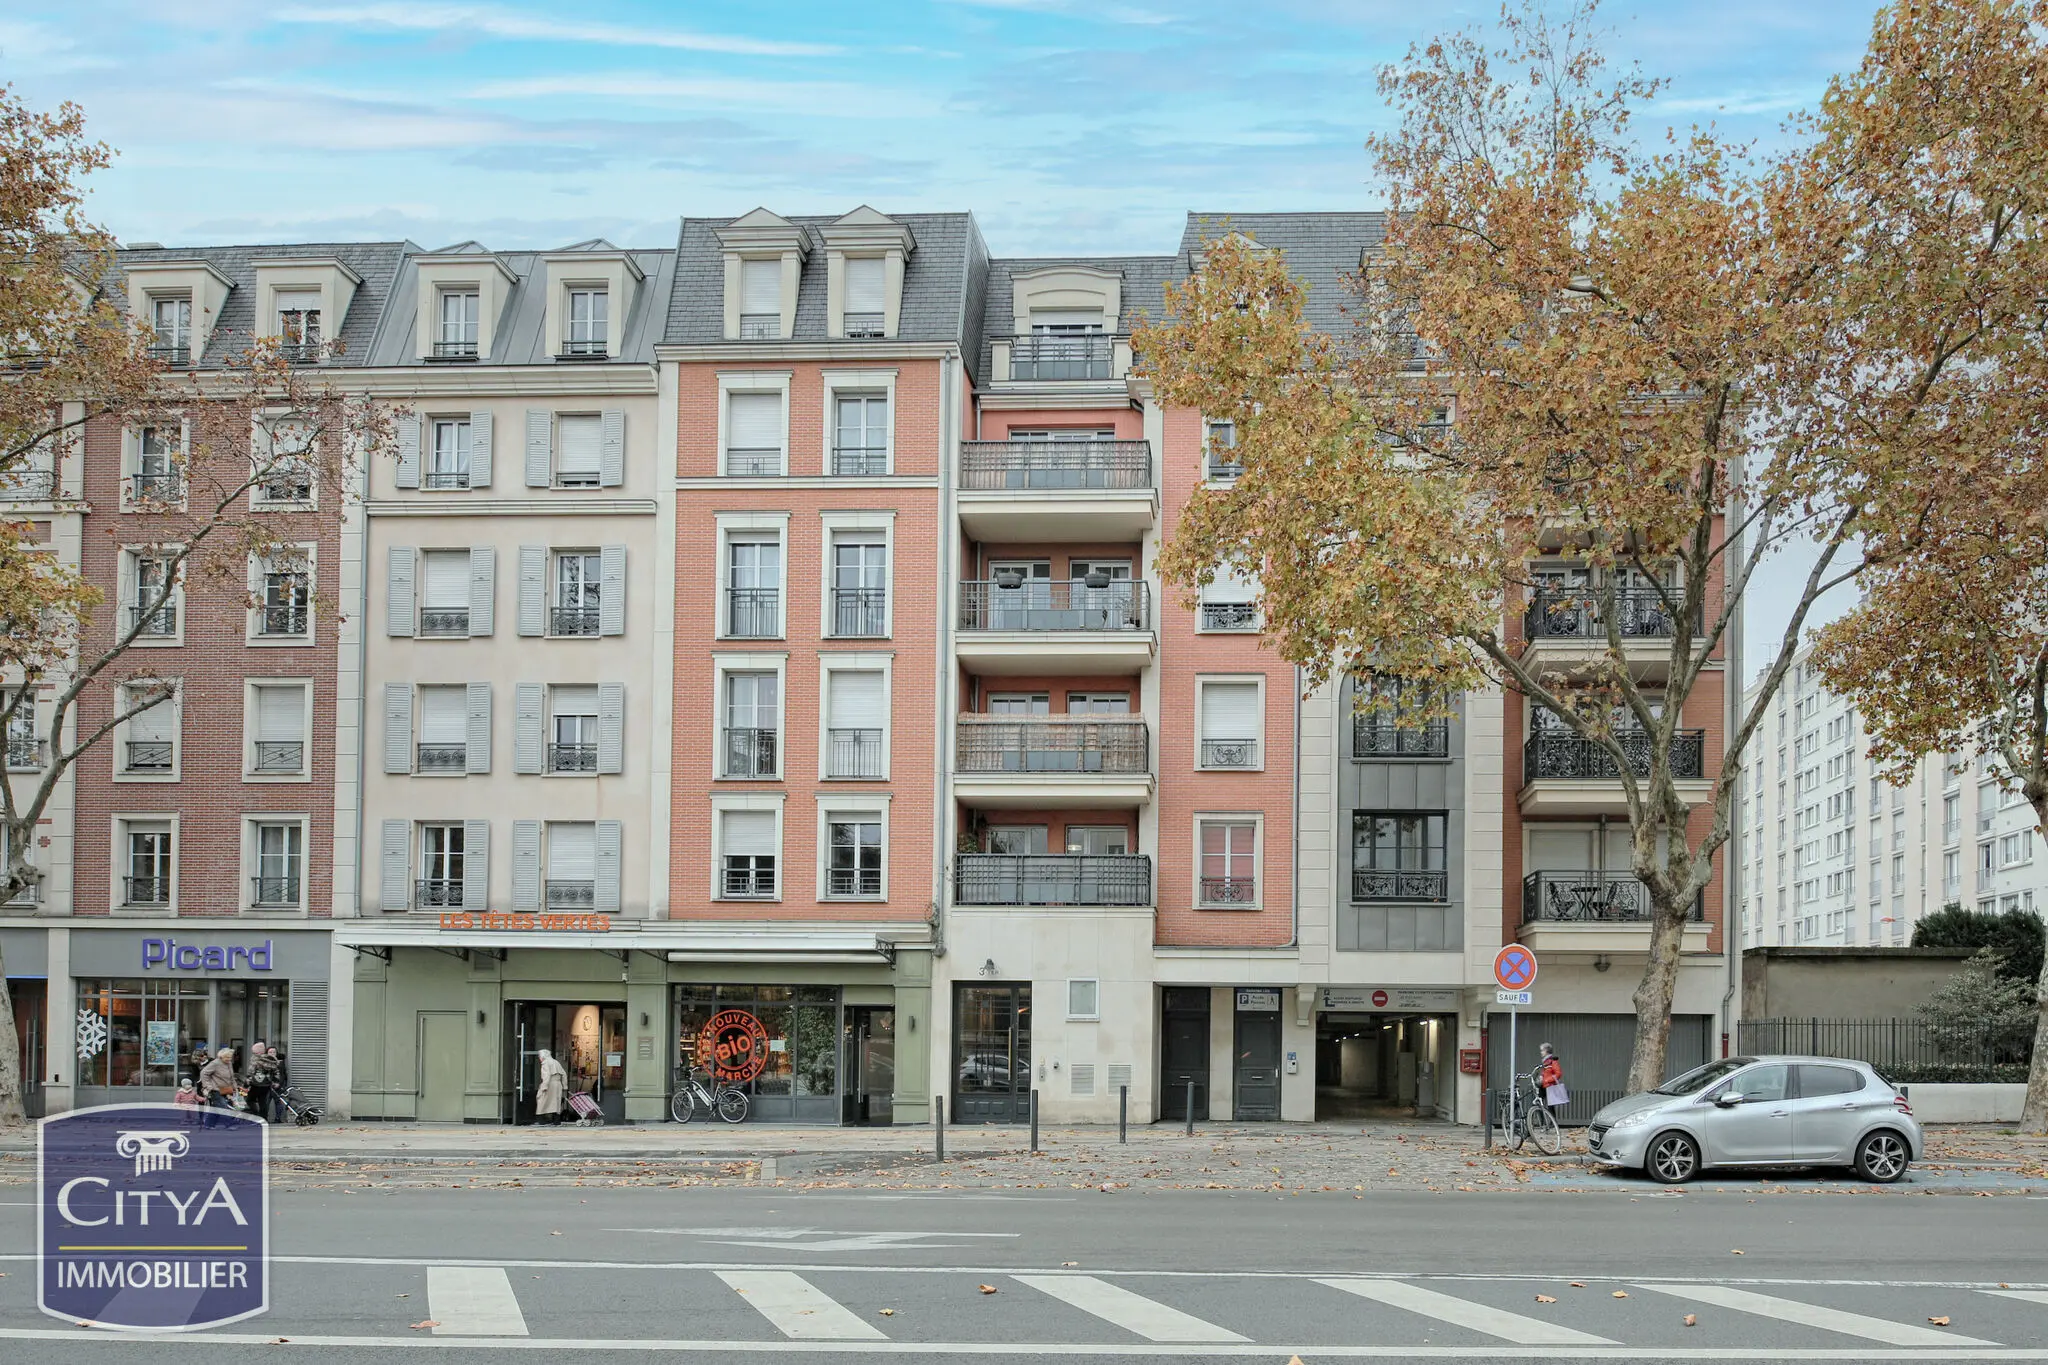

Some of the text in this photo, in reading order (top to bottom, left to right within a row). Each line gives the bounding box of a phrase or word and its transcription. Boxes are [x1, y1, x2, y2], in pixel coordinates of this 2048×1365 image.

[439, 910, 610, 931] LES TÊTES VERTES
[142, 938, 273, 970] Picard
[1499, 993, 1518, 1001] SAUF
[707, 1014, 762, 1037] NOUVEAU
